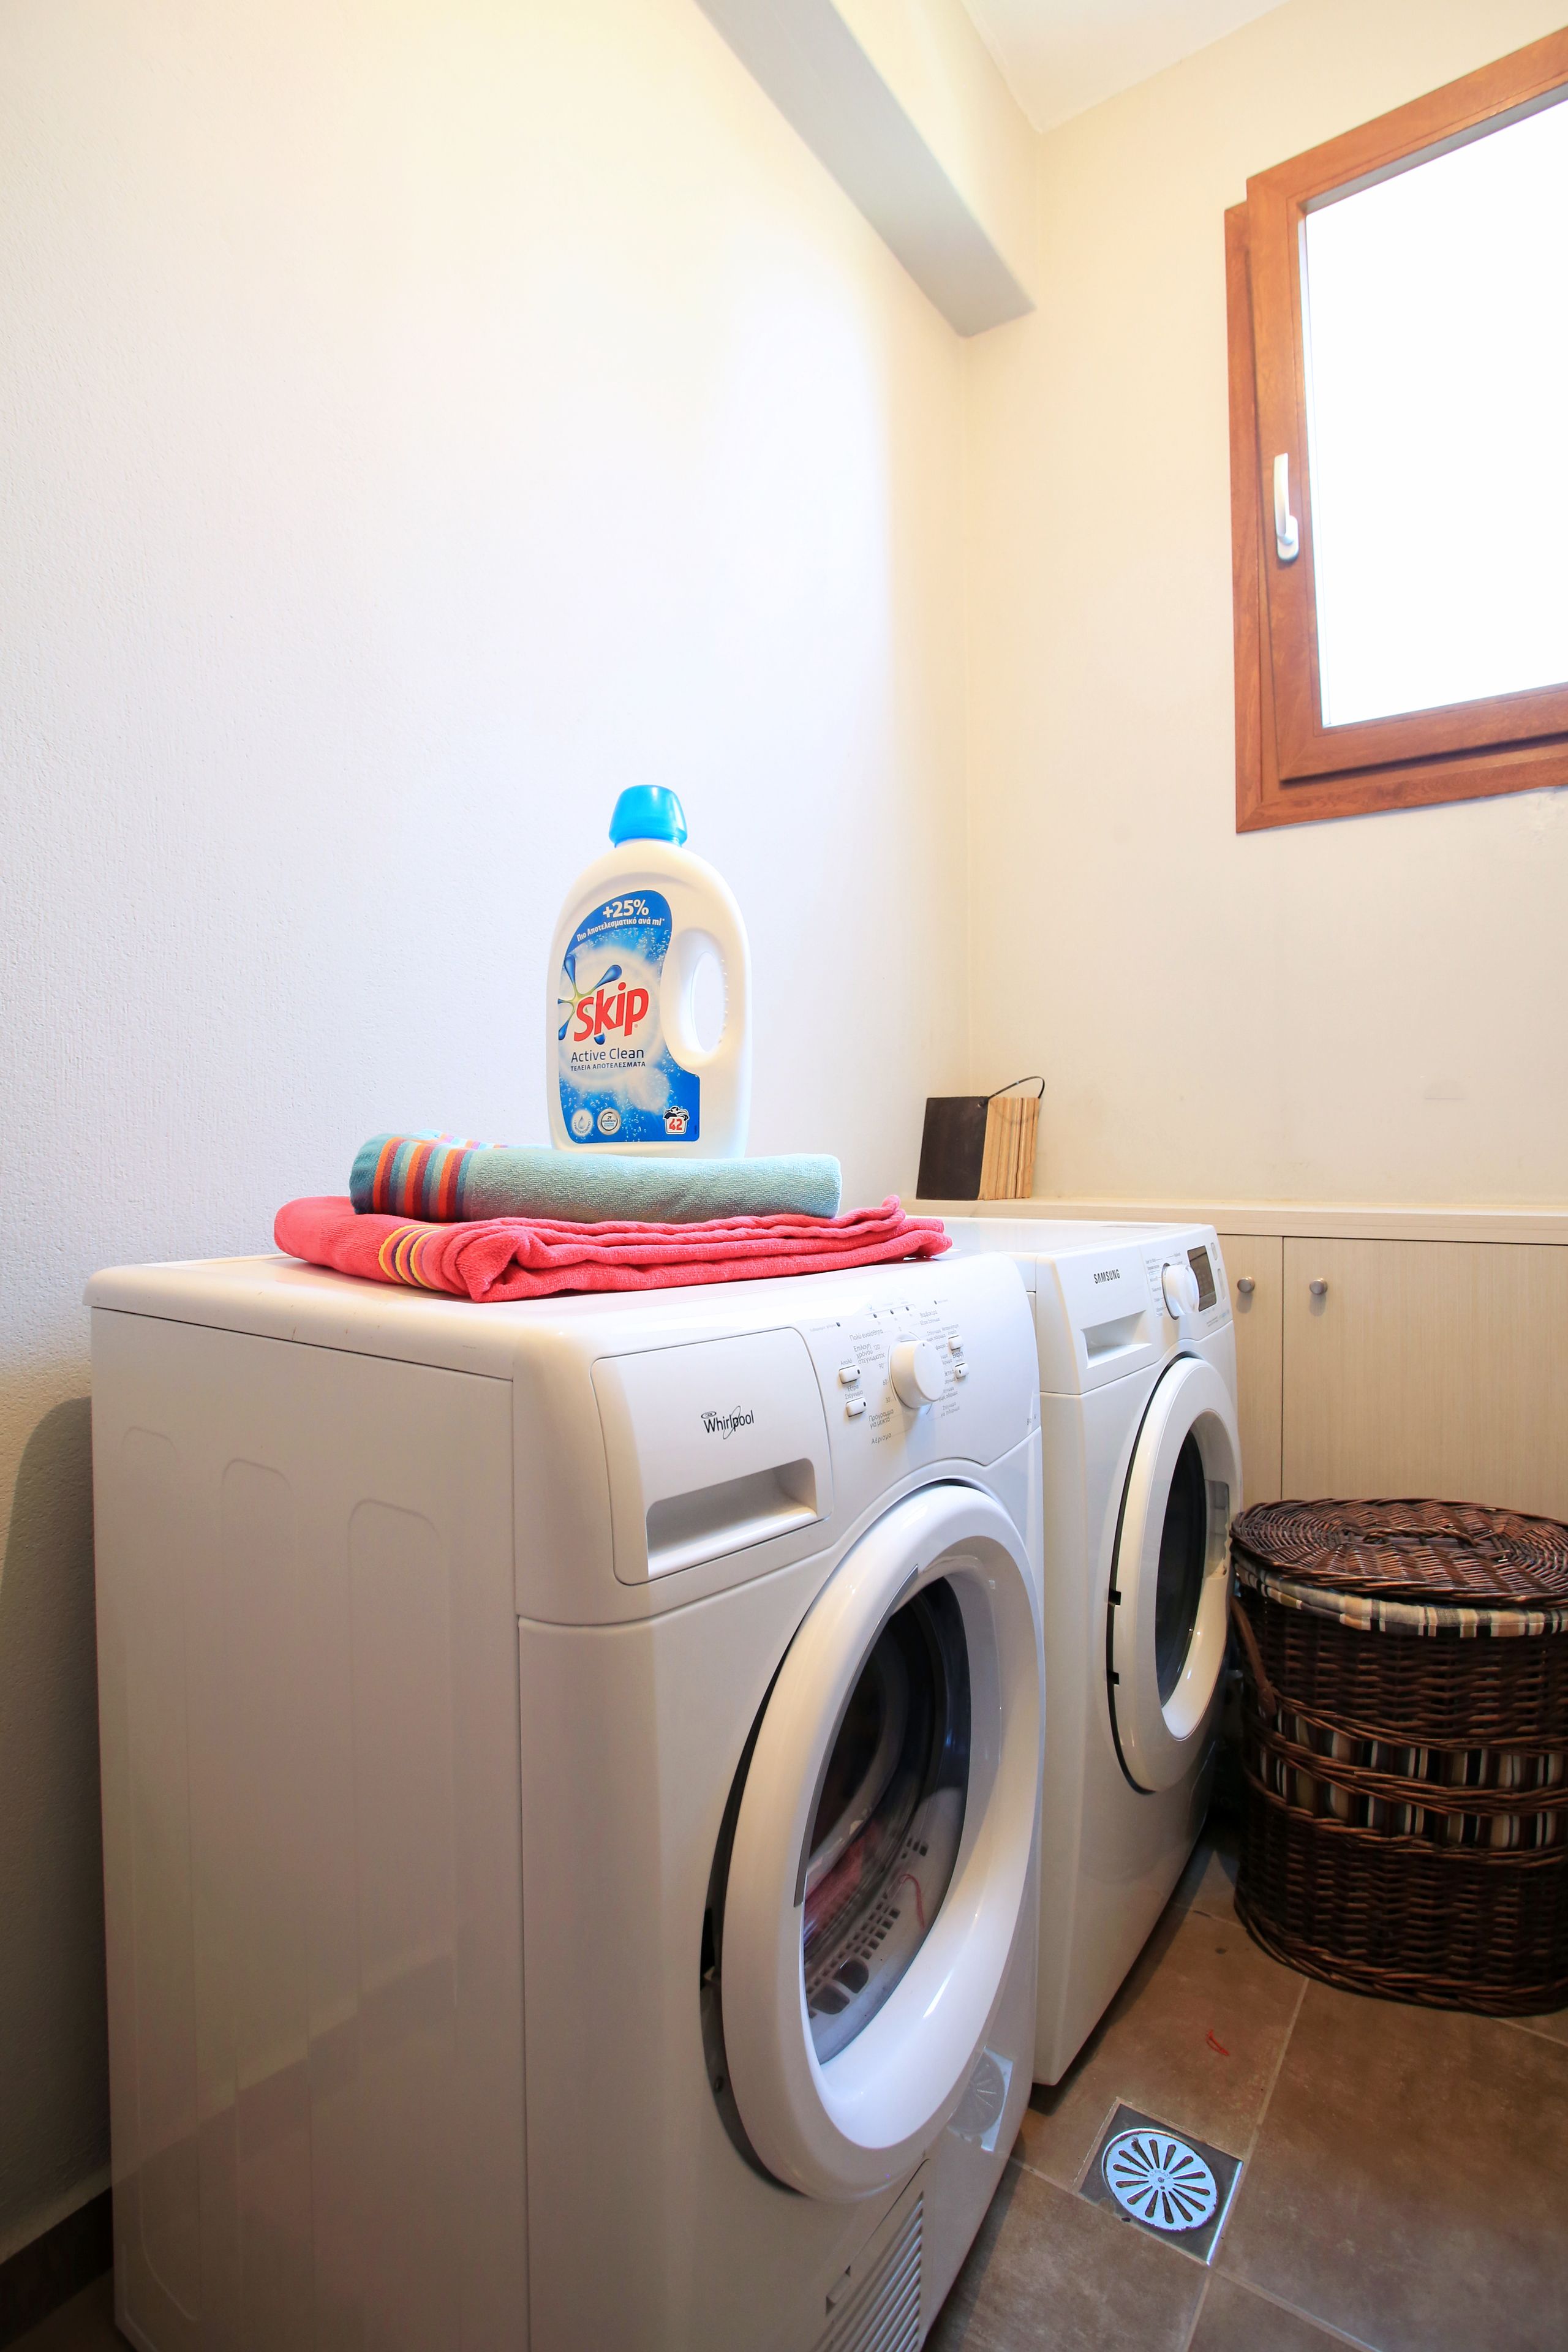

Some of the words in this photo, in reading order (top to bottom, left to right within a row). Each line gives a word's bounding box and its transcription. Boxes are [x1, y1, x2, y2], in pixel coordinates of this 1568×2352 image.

[602, 899, 649, 918] +25%
[576, 931, 587, 942] Πιο
[587, 916, 637, 936] Αποτελεσματικό
[638, 916, 651, 925] ανά
[571, 1049, 606, 1063] Active
[609, 1047, 644, 1060] Clean
[668, 1118, 683, 1131] 42
[1093, 1268, 1120, 1284] SAMSUNG
[703, 1409, 755, 1433] Whirlpool
